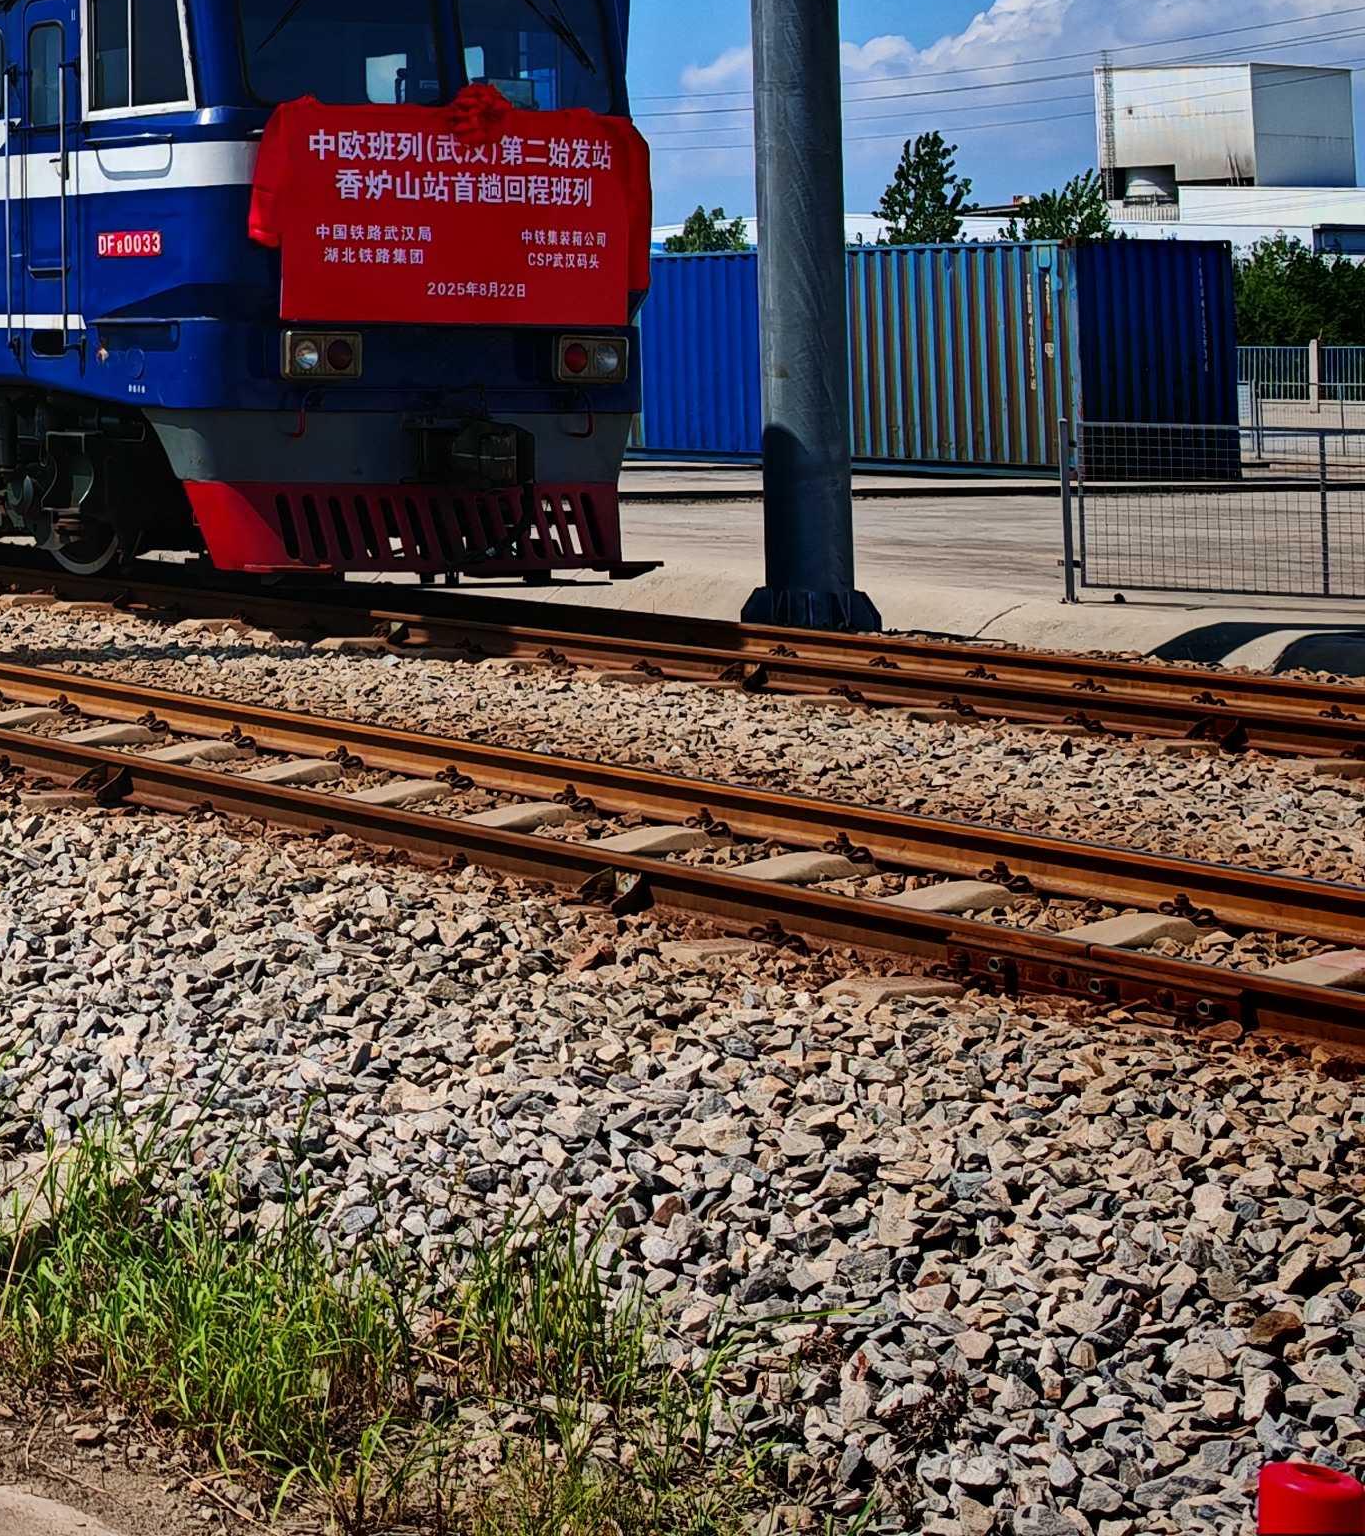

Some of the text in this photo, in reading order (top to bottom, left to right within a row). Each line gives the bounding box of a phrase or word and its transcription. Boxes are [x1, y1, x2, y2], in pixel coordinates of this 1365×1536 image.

[335, 168, 593, 207] 香炉山站首趟回程班列
[315, 224, 432, 242] 中国铁路武汉局
[521, 229, 607, 248] 中铁集装箱公司
[323, 247, 425, 265] 湖北铁路集团
[527, 252, 600, 269] CSP武汉码头
[426, 281, 526, 298] 2025年8月22日
